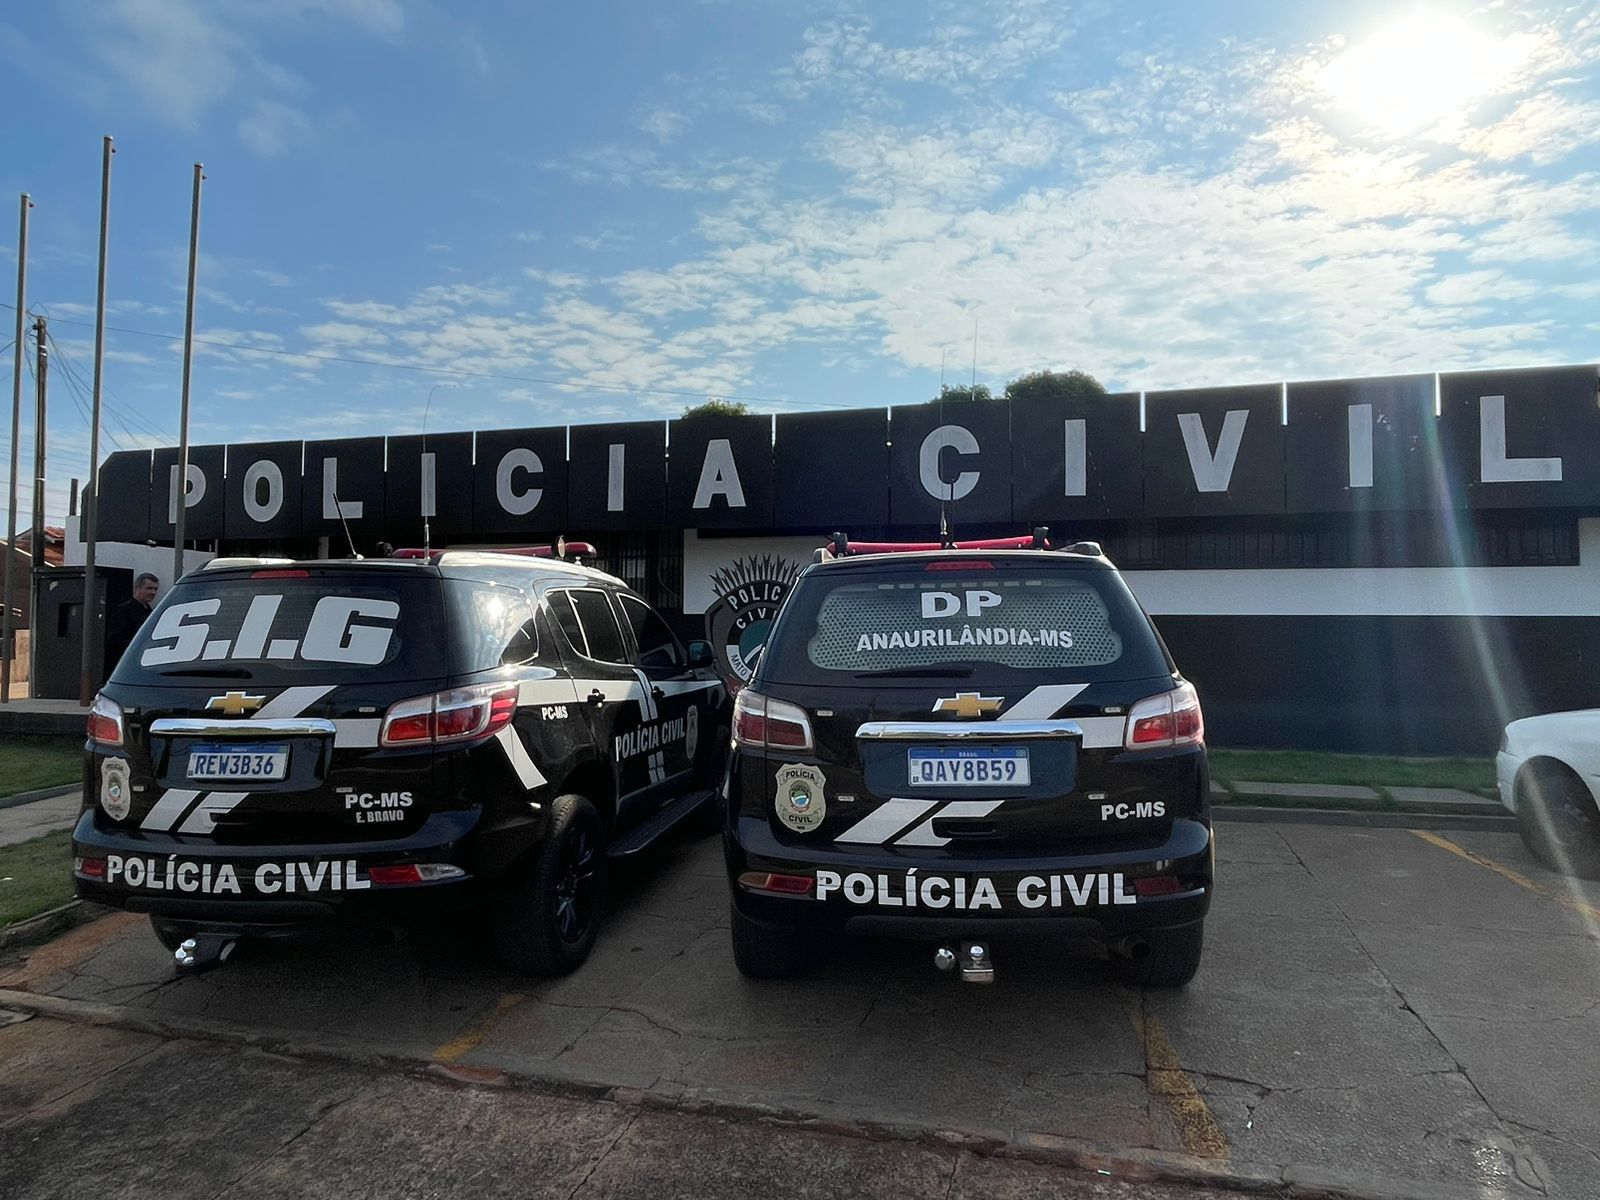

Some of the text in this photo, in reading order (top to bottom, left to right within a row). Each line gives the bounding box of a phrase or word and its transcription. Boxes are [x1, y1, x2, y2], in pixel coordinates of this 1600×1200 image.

[168, 395, 1562, 524] POLICIA CIVIL
[727, 583, 782, 610] POLIC
[921, 590, 1002, 618] DP
[140, 594, 400, 667] S.I.G
[736, 607, 777, 630] CIV
[856, 624, 1073, 651] ANAURILÂNDIA-MS
[541, 705, 568, 720] PC-MS
[615, 717, 686, 762] POLÍCIA CIVIL
[194, 755, 274, 775] REW3B36
[921, 760, 1016, 782] QAY8B59
[345, 791, 413, 809] PC-MS
[1101, 801, 1166, 821] PC-MS
[366, 809, 404, 822] BRAVO
[788, 814, 813, 823] CIVIL
[107, 854, 371, 894] POLÍCIA CIVIL
[815, 868, 1137, 909] POLÍCIA CIVIL
